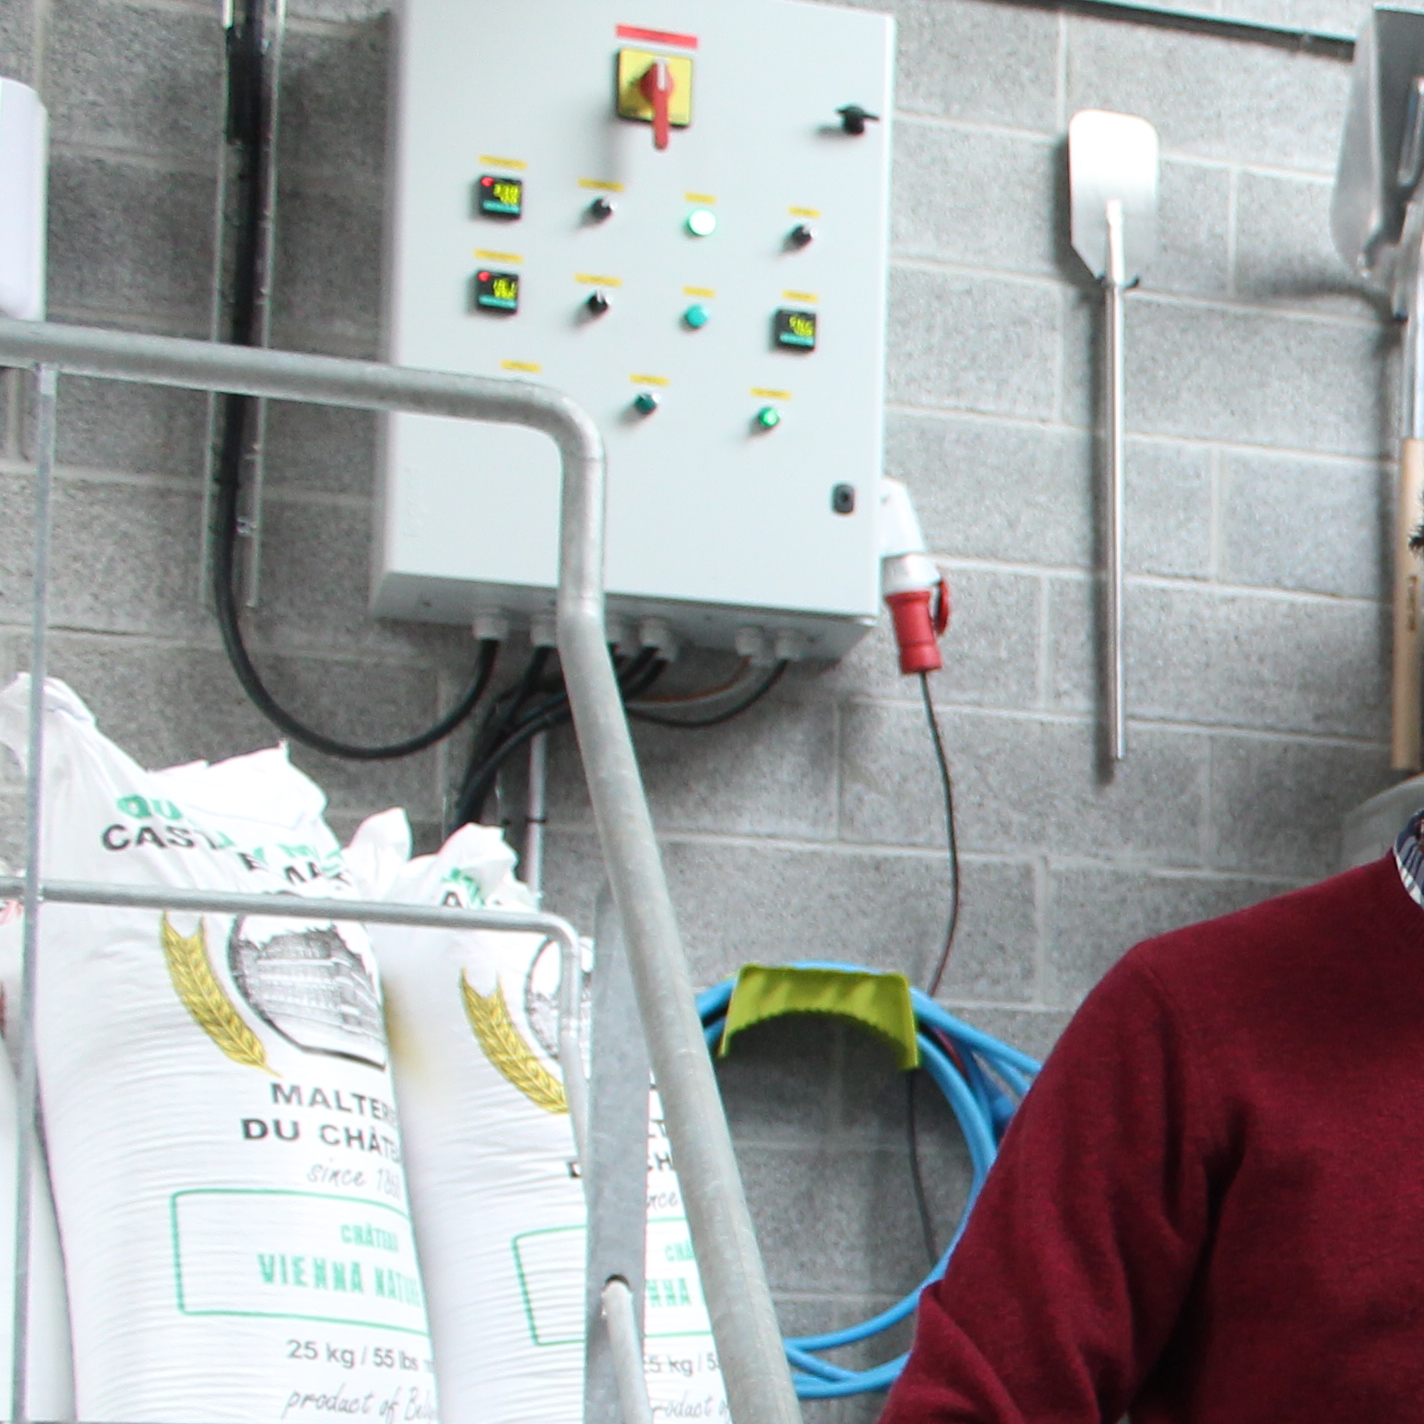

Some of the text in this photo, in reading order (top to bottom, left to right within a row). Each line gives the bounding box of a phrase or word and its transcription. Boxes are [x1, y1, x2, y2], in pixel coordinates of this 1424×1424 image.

[240, 1118, 301, 1141] DU
[307, 1157, 366, 1188] since
[257, 1254, 364, 1294] VIENNA
[286, 1339, 318, 1360] 25
[326, 1342, 356, 1369] kg
[373, 1347, 395, 1368] 55
[669, 1351, 693, 1376] kg
[280, 1383, 375, 1420] product
